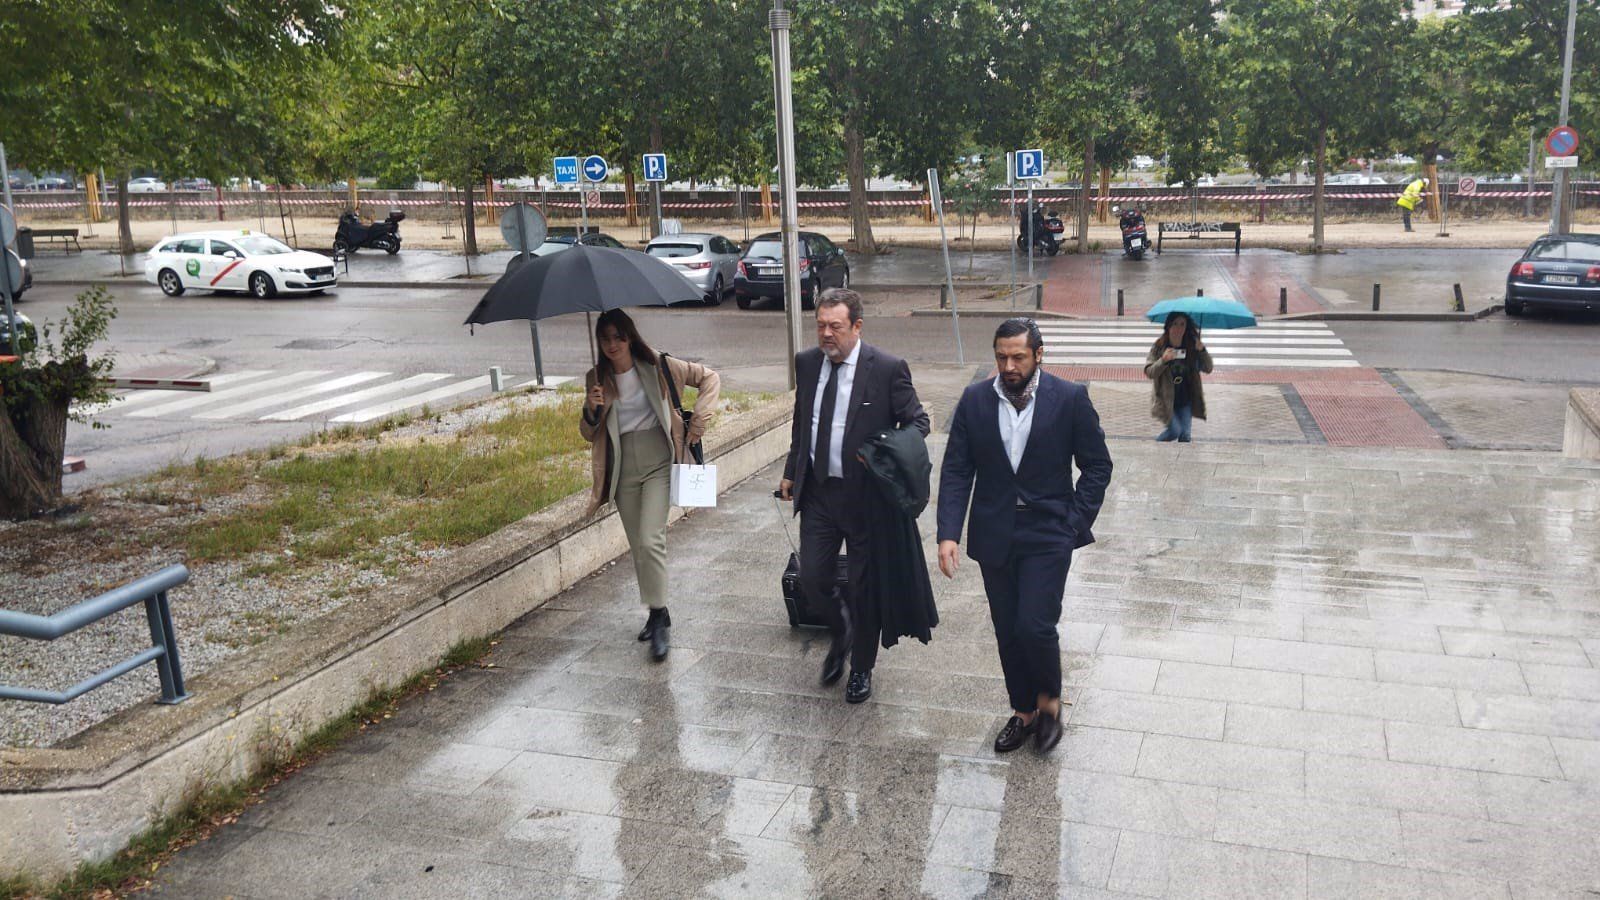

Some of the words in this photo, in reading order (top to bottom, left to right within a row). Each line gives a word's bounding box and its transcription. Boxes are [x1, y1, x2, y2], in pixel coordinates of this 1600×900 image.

[556, 166, 576, 175] TAXI
[648, 156, 659, 178] P
[1022, 152, 1035, 176] P
